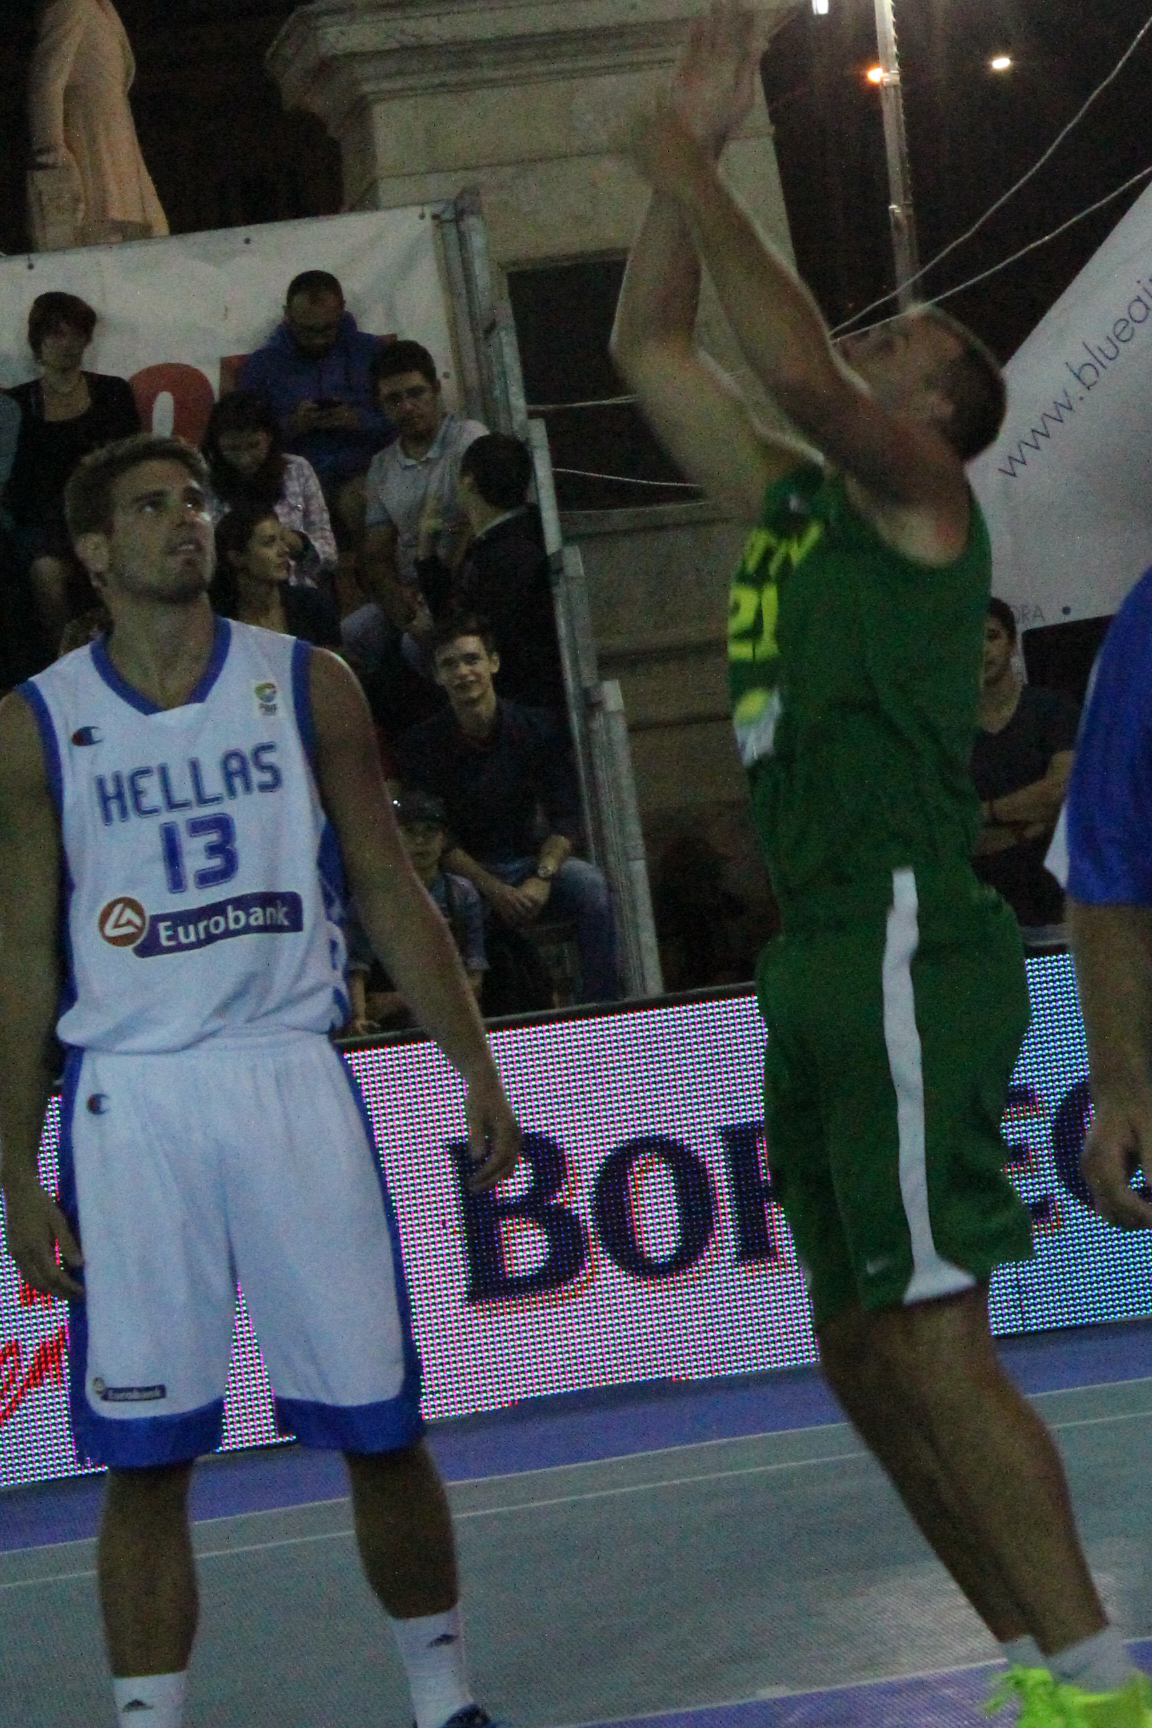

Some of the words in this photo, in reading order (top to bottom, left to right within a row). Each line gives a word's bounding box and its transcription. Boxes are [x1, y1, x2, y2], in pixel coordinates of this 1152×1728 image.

[94, 740, 282, 827] HELLAS
[159, 812, 239, 895] 13
[157, 900, 290, 947] Eurobank
